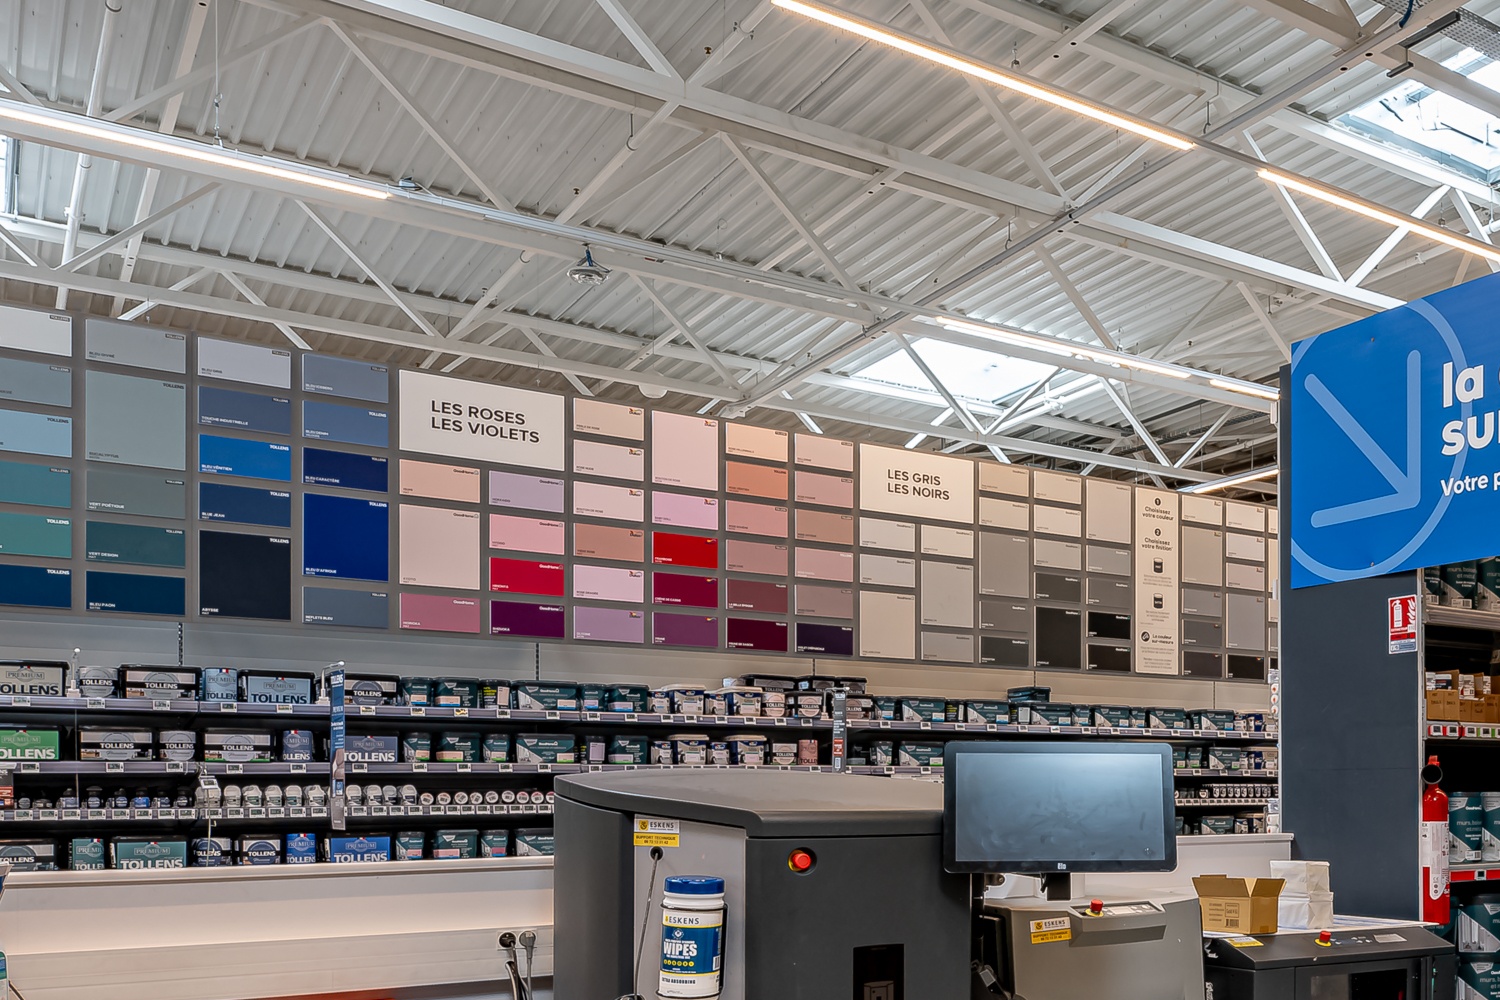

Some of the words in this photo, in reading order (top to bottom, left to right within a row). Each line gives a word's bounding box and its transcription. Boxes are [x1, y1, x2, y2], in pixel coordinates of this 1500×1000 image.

[1442, 361, 1485, 408] la
[431, 400, 463, 416] LES
[468, 405, 526, 425] ROSES
[220, 418, 249, 426] INDUSTRIELLE
[431, 416, 463, 432] LES
[468, 421, 540, 443] VIOLETS
[887, 468, 909, 481] LES
[912, 473, 941, 486] GRIS
[1440, 473, 1489, 498] Votre
[887, 482, 909, 495] LES
[912, 486, 950, 501] NOIRS
[1144, 506, 1171, 515] Choisissez
[1144, 537, 1171, 546] Choisissez
[0, 684, 59, 695] OLLENS
[251, 693, 307, 704] TOLLENS
[0, 748, 55, 760] OLLENS
[343, 752, 395, 762] TOLLENS
[650, 821, 674, 829] ESKENS
[286, 856, 316, 864] TOLLENS
[334, 853, 388, 863] TOLLENS
[120, 859, 184, 869] TOLLENS
[669, 916, 700, 925] ESKENS
[663, 942, 698, 957] WIPES
